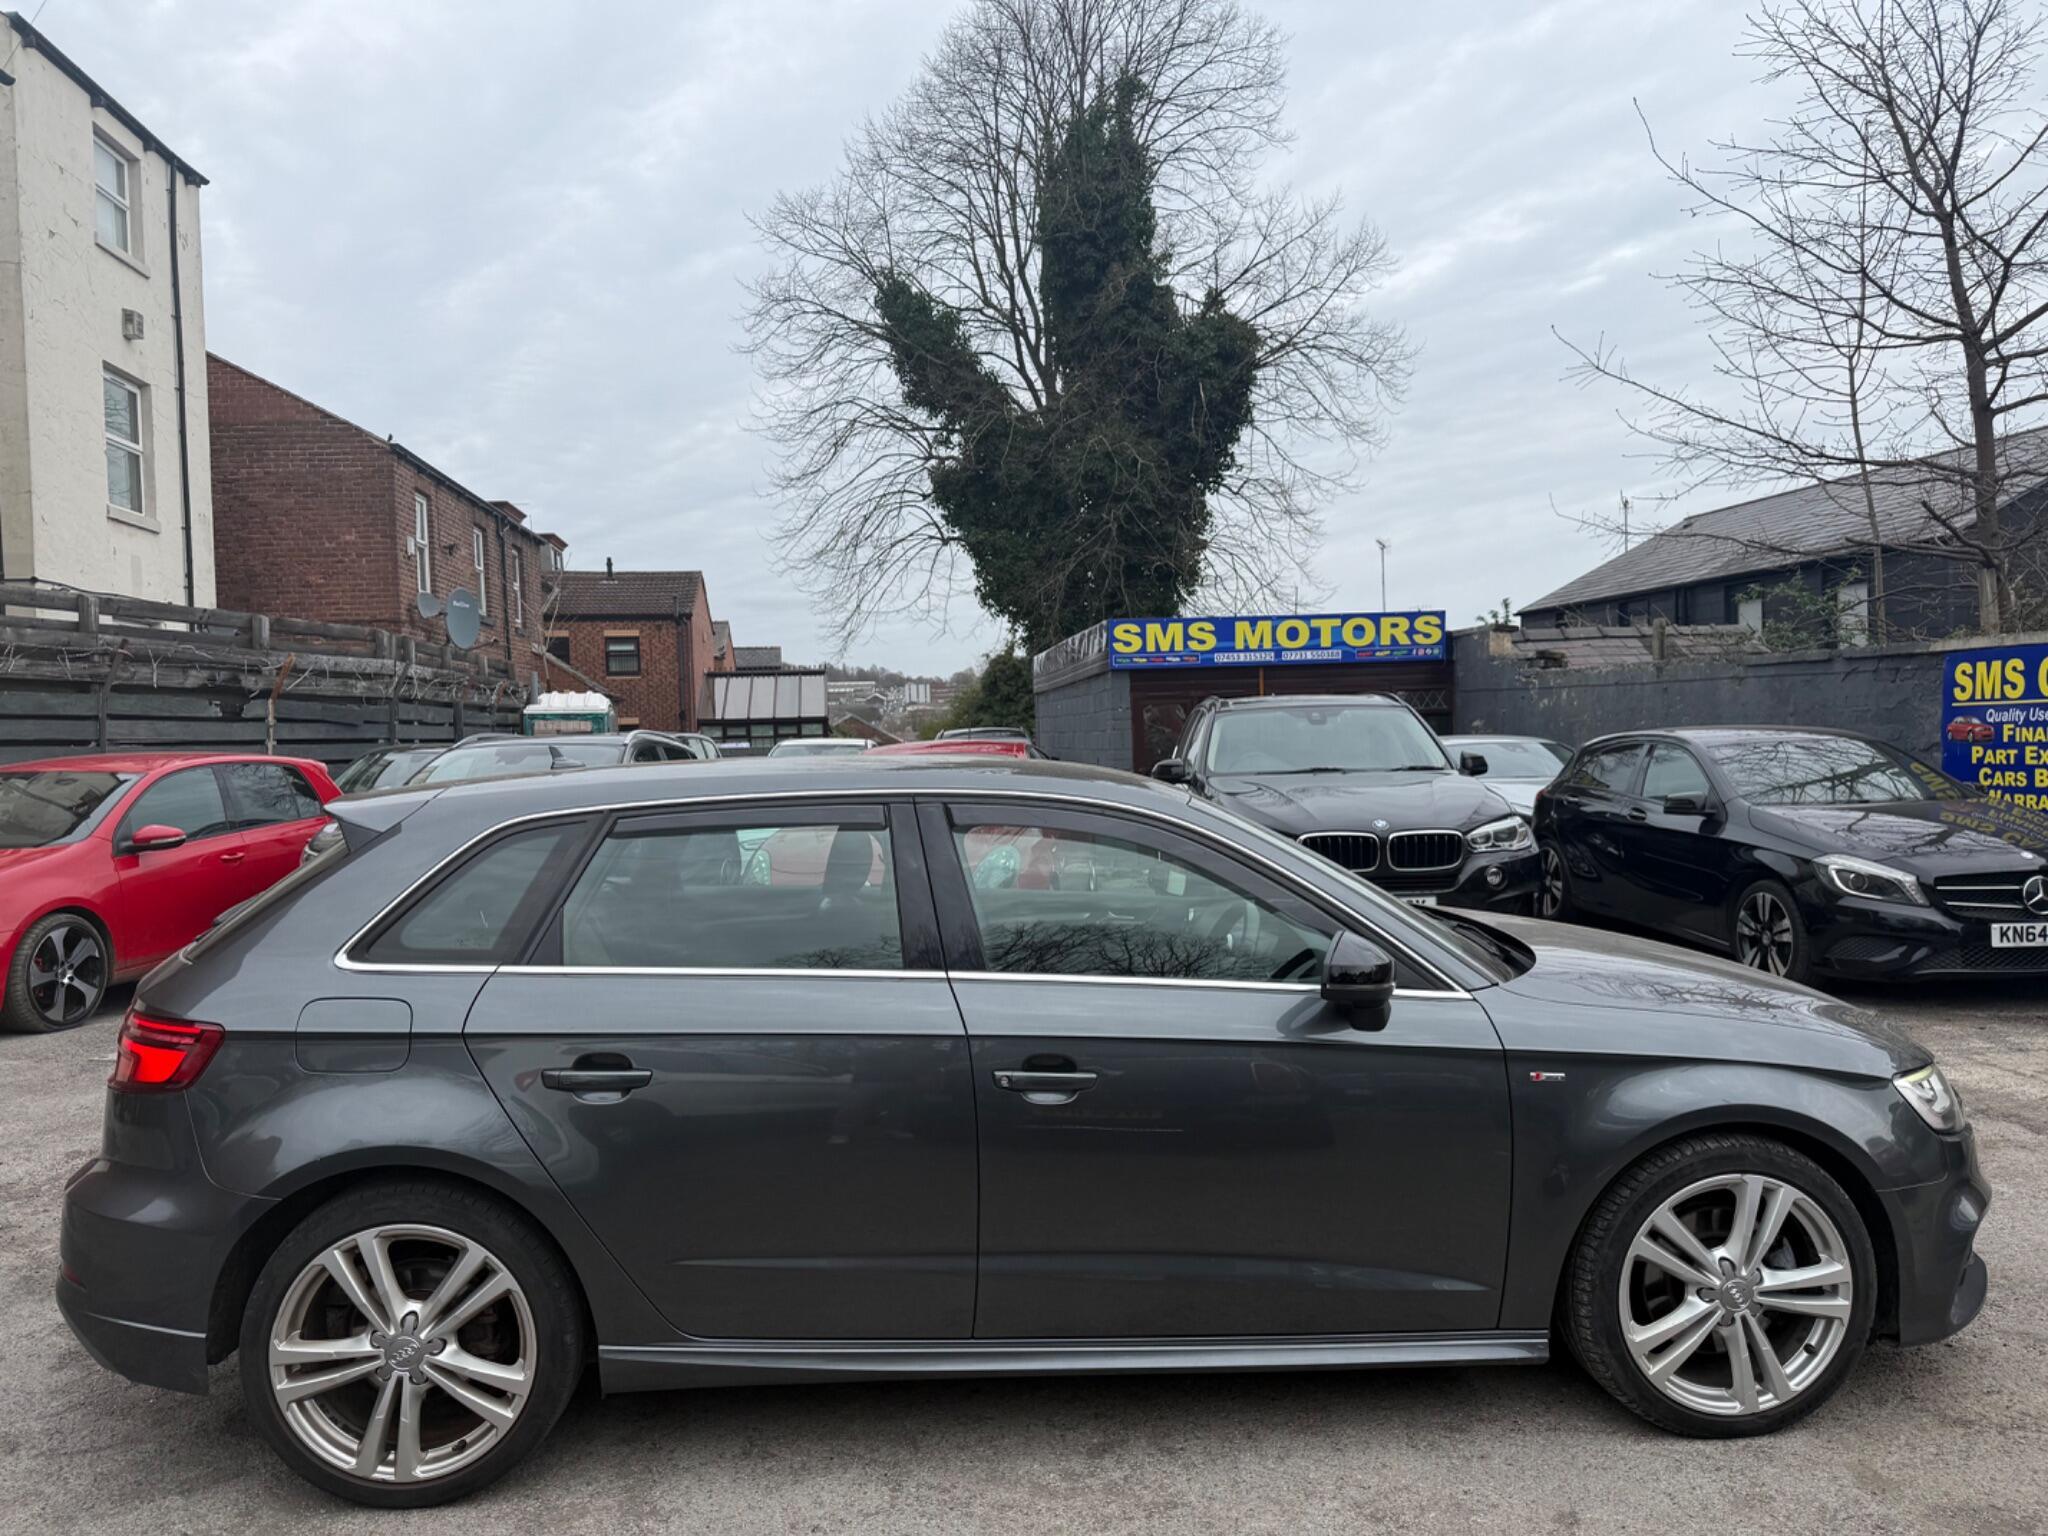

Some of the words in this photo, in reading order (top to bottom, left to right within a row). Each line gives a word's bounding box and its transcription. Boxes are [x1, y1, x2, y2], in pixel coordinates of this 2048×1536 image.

[1113, 622, 1217, 653] SMS
[1234, 615, 1442, 650] MOTORS
[1953, 658, 2026, 701] SMS
[1986, 708, 2028, 725] Quality
[2002, 723, 2048, 743] FINA
[1971, 745, 2019, 765] PART
[1979, 767, 2028, 787] CARS
[2000, 925, 2048, 943] KN64
